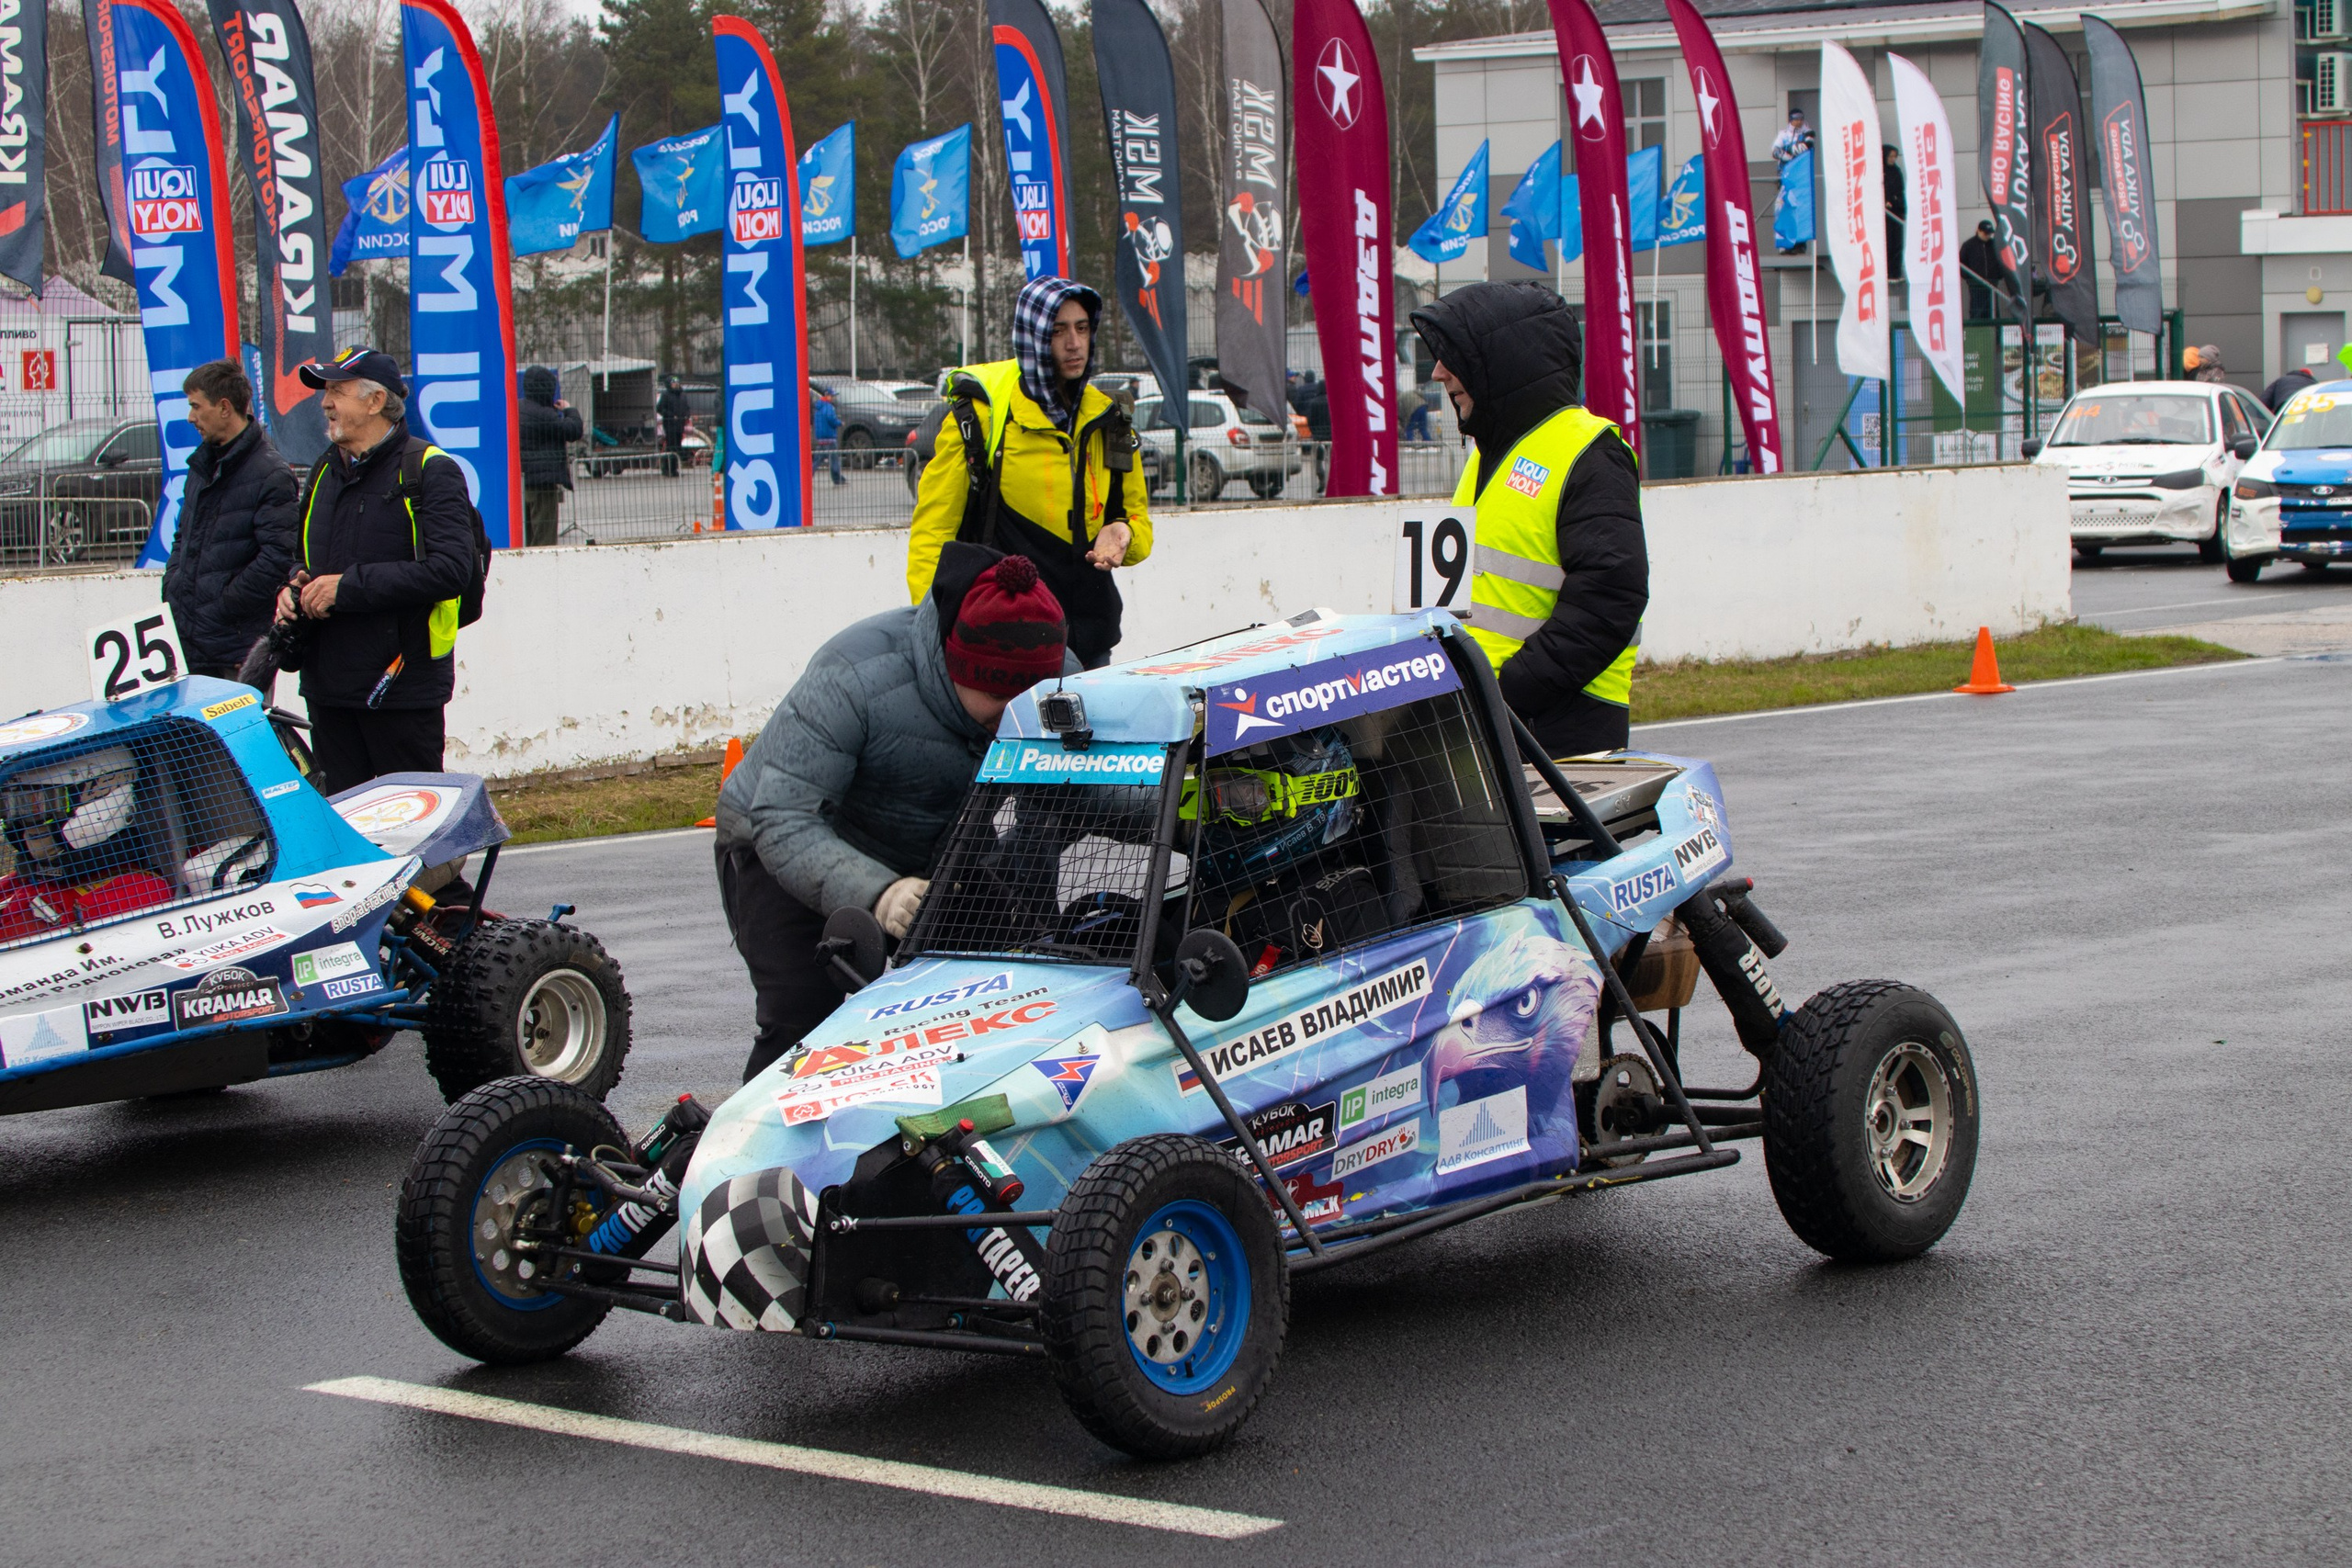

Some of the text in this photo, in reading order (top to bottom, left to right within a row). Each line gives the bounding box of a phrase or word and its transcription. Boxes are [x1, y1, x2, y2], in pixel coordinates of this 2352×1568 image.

[2287, 393, 2339, 415] 85
[1513, 457, 1550, 483] LIQUI
[1508, 473, 1542, 497] MOLY
[1402, 517, 1468, 608] 19
[94, 614, 178, 699] 25
[1265, 652, 1446, 719] спортмастер
[205, 696, 253, 719] Sabelt
[1018, 748, 1165, 773] Раменское
[1279, 829, 1307, 852] Исаев
[1316, 812, 1327, 824] 19
[1673, 829, 1718, 869] NWB
[1614, 864, 1676, 911] RUSTA
[331, 877, 409, 934] shop.at-racing.ru
[156, 901, 276, 940] В.Лужков
[193, 926, 276, 957] YUKA ADV
[79, 955, 126, 972] Им.
[298, 961, 312, 979] IP
[319, 950, 362, 971] integra
[209, 970, 245, 987] КУБОК
[327, 976, 384, 998] RUSTA
[89, 991, 167, 1019] NWB
[184, 987, 276, 1019] KRAMAR
[868, 973, 1009, 1021] RUSTA
[883, 987, 1048, 1036] Racing Team
[212, 1005, 277, 1022] MOTORSPORT
[1210, 963, 1428, 1076] ИСАЕВ ВЛАДИМИР
[792, 1000, 1059, 1080] АЛЕКС
[901, 1045, 952, 1065] ADV
[840, 1058, 946, 1086] PRO RACING
[1371, 1077, 1419, 1106] integra
[1251, 1104, 1297, 1130] КУБОК
[1345, 1095, 1363, 1120] IP
[640, 1123, 666, 1151] CFMOTO
[1333, 1136, 1398, 1176] DRYDRY
[1439, 1137, 1525, 1169] АДВ Консалтинг
[965, 1155, 991, 1188] CFMOTO
